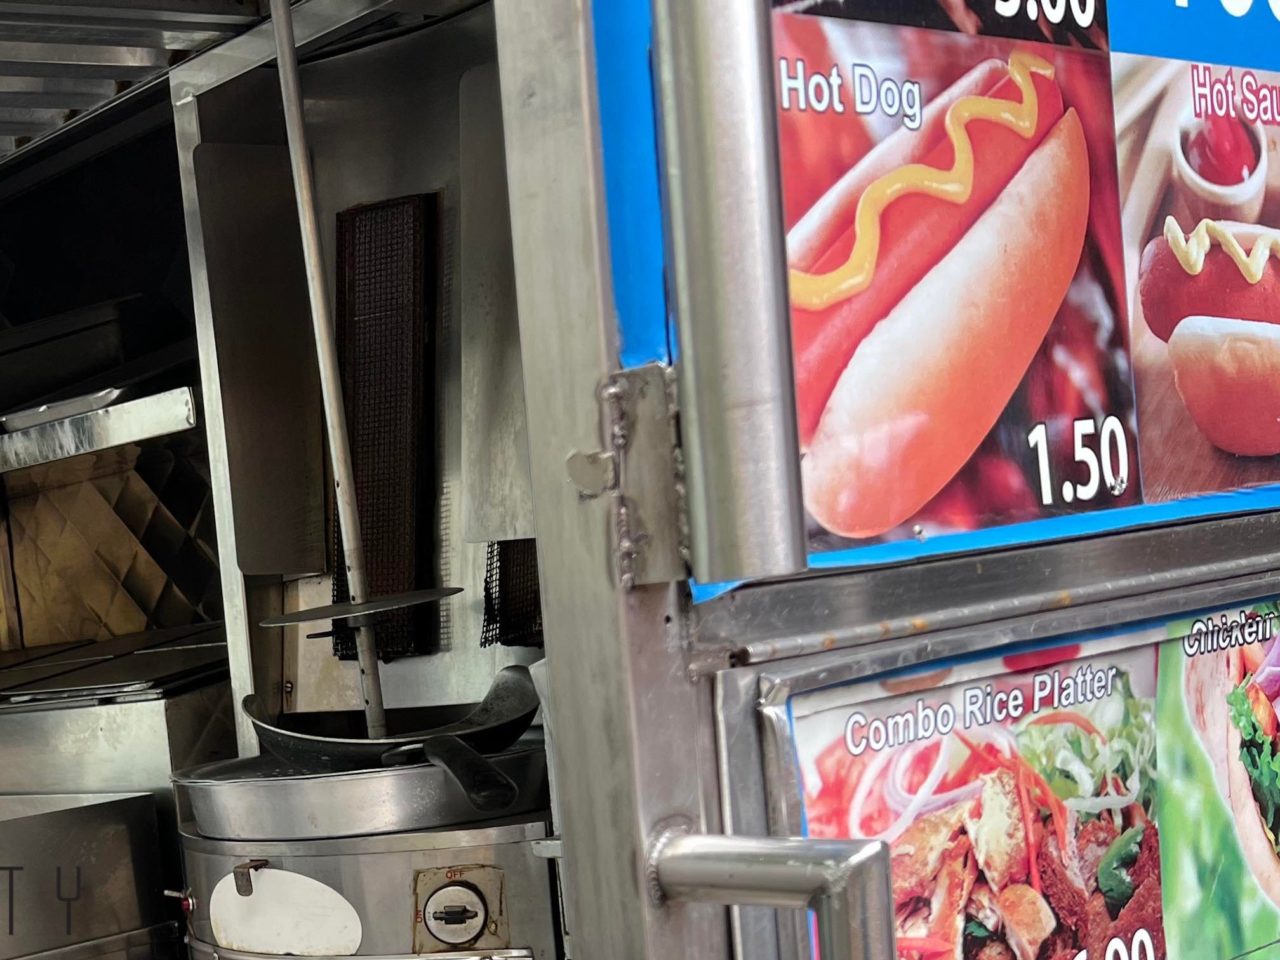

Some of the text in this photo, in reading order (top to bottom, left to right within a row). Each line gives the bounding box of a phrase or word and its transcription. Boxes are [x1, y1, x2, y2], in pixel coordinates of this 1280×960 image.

[779, 57, 922, 131] Hot Dog
[1191, 64, 1236, 119] Hot
[1028, 415, 1128, 505] 1.50
[844, 664, 1117, 757] Combo Rice Platter
